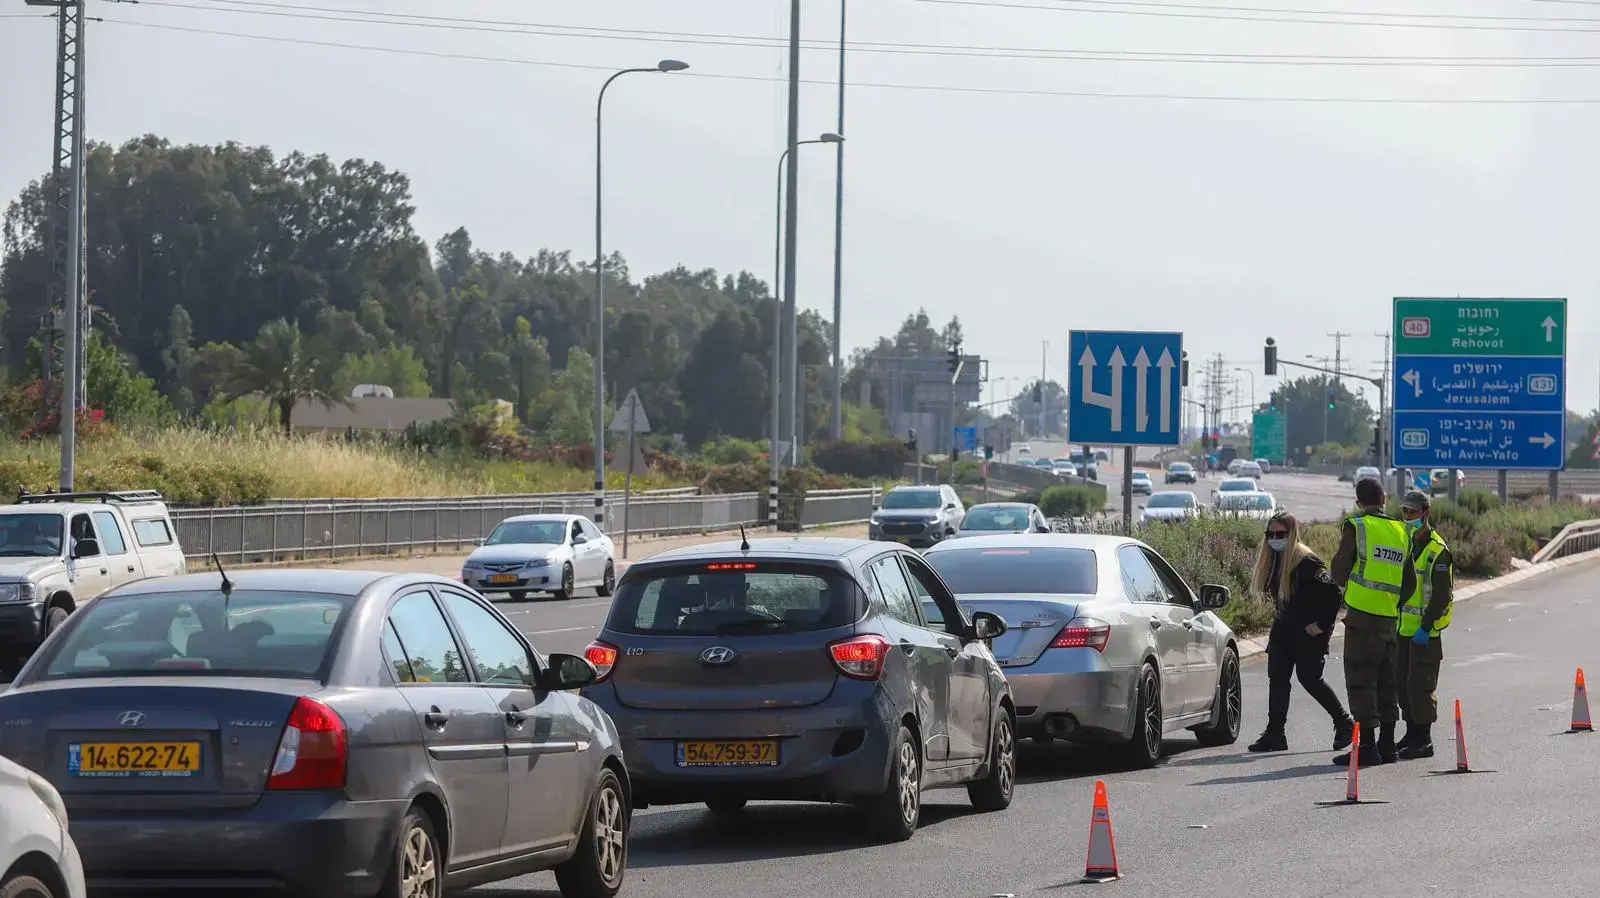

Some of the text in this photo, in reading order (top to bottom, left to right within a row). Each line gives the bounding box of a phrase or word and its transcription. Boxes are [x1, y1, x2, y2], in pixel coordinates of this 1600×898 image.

[1458, 308, 1500, 319] רחובות
[1409, 323, 1423, 332] 40
[1457, 324, 1500, 336] رحوبوت
[1452, 338, 1504, 348] Rehovot
[1453, 363, 1503, 374] ירושלים
[1532, 379, 1553, 390] 431
[1444, 394, 1510, 404] Jerusalem
[1439, 419, 1516, 430] תל אביב-יפו
[1405, 434, 1425, 445] 431
[1499, 436, 1513, 449] تل
[1434, 449, 1519, 460] Tel Aviv-Yafo
[1373, 547, 1404, 563] מתנדב
